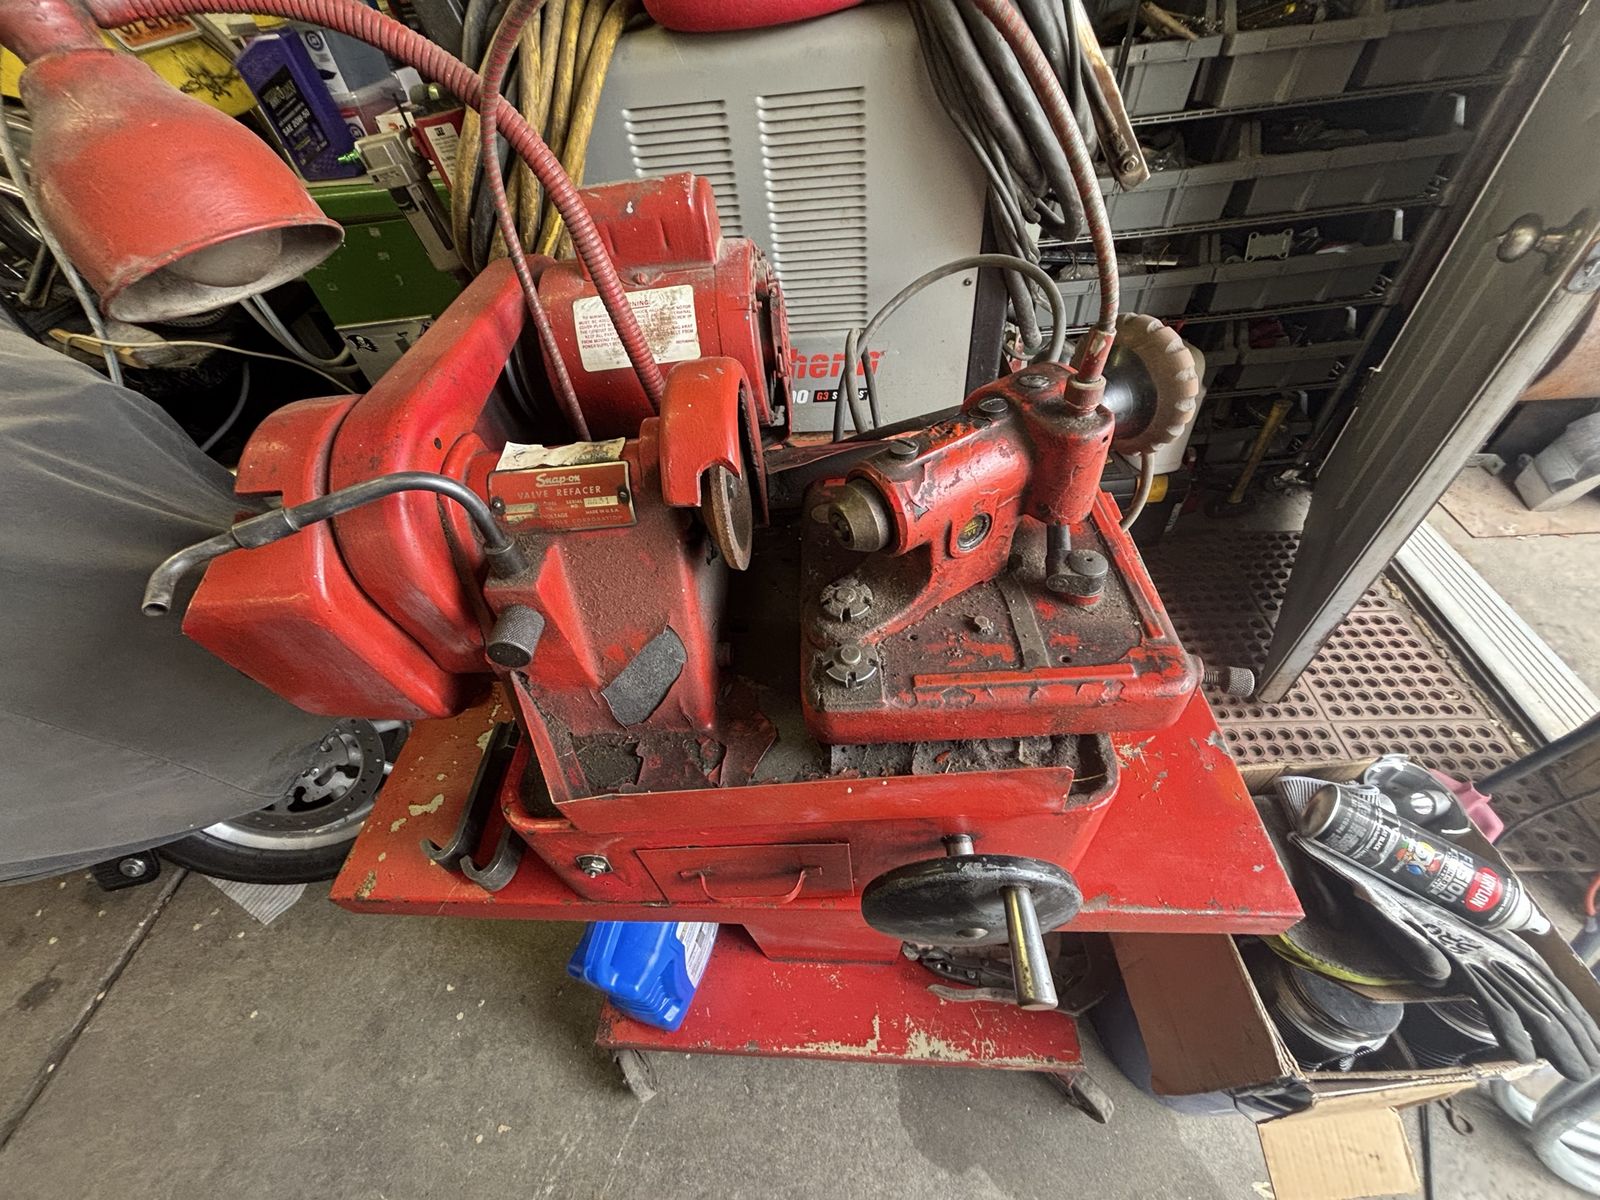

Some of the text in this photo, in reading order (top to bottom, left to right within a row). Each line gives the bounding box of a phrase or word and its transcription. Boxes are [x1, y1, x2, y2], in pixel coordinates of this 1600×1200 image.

[281, 123, 294, 137] SAE
[291, 107, 311, 128] 20W-50
[816, 391, 829, 401] G3
[535, 473, 581, 487] Snap-on
[517, 485, 602, 501] VALVE REFACER
[543, 512, 569, 520] VOLTAGE
[1373, 836, 1386, 852] BLACK
[1440, 854, 1474, 904] FUSION
[1470, 874, 1497, 909] KRYLON
